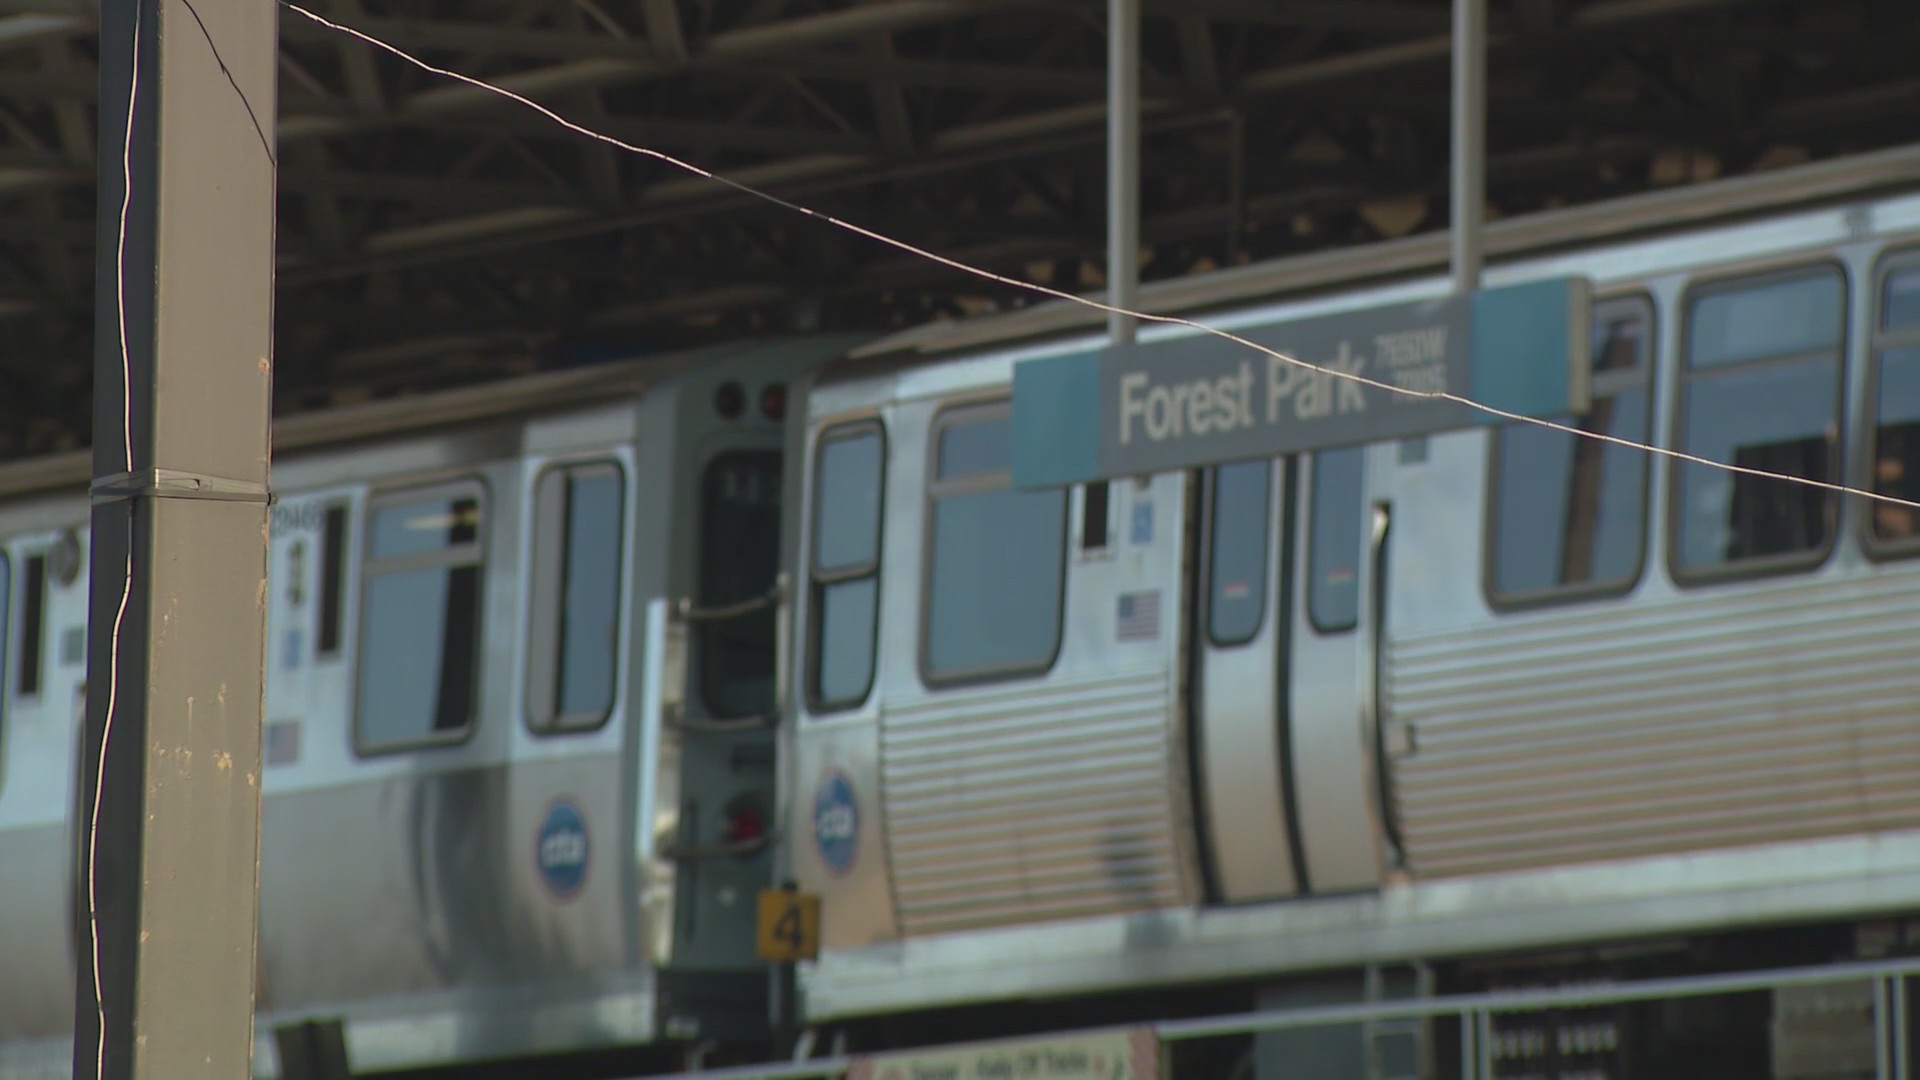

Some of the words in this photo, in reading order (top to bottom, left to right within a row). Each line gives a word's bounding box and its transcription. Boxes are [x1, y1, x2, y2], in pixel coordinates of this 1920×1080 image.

[1119, 361, 1256, 446] Forest
[1264, 343, 1367, 424] Park
[773, 905, 804, 951] 4
